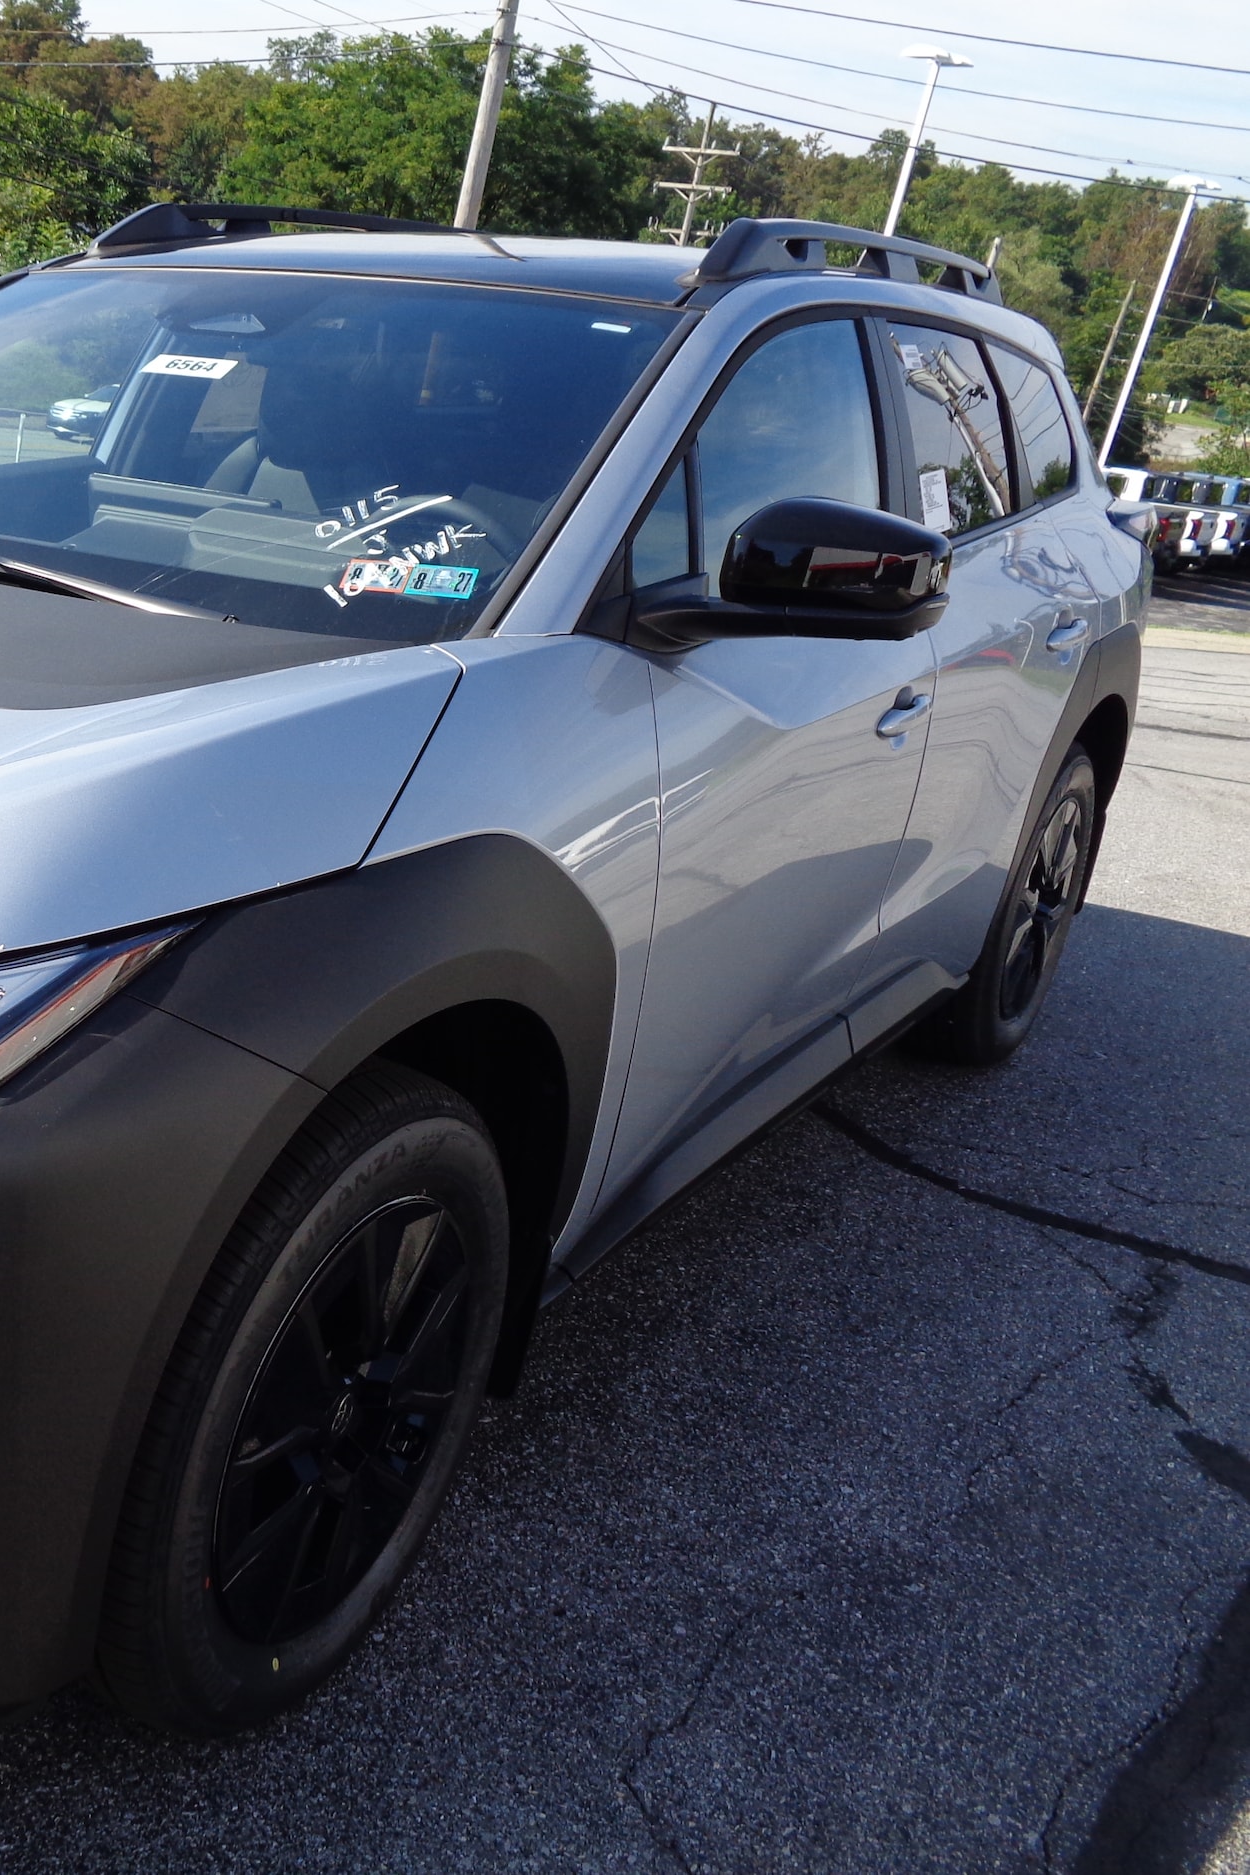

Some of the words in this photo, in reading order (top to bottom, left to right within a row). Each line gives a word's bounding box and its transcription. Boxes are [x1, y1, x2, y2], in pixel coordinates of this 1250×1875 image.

[164, 358, 218, 372] 6564
[413, 572, 428, 590] 8
[453, 571, 473, 593] 27
[276, 1142, 407, 1284] TURANZA
